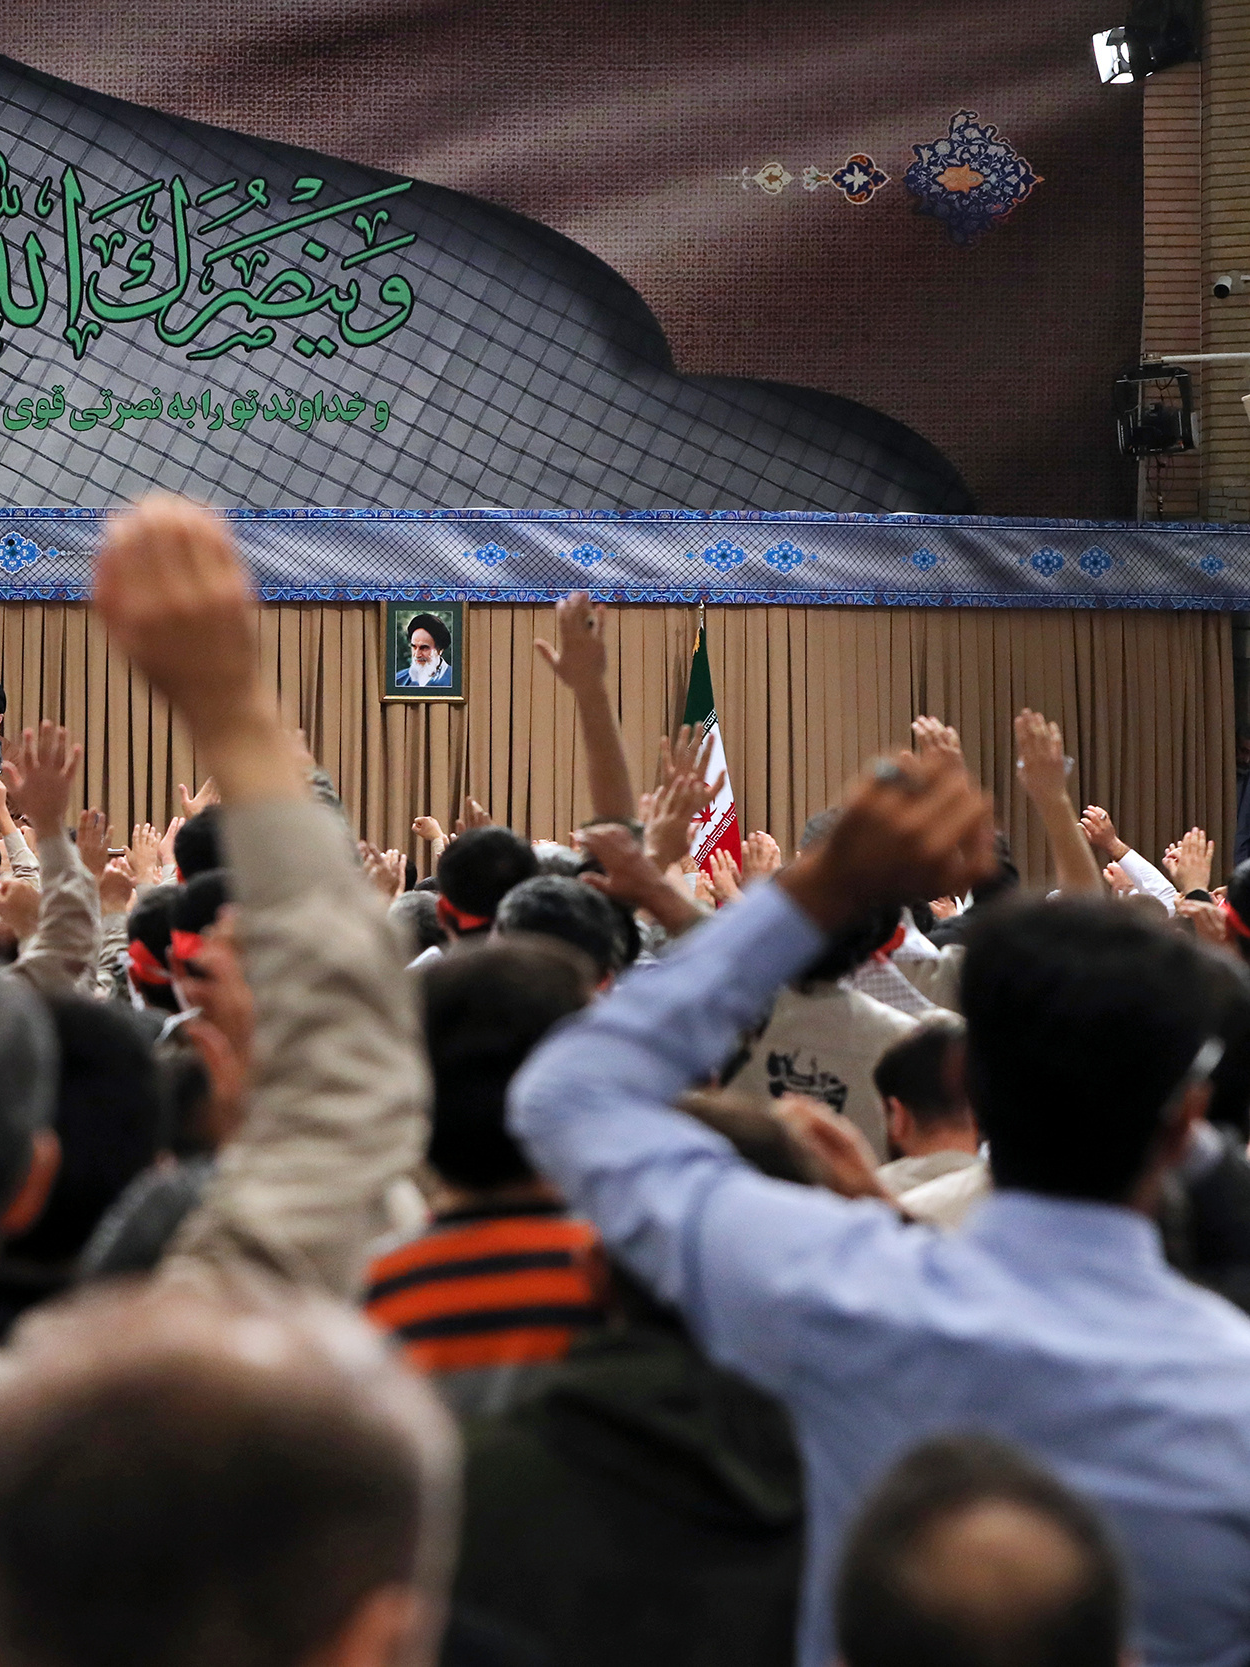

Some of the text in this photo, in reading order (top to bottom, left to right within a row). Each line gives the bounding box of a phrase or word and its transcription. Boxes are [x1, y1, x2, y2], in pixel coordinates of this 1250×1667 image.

[2, 383, 67, 432] قوی
[165, 393, 197, 430] به
[200, 390, 225, 431] را
[228, 389, 259, 431] تو
[261, 388, 367, 433] خداوند
[370, 400, 390, 433] و
